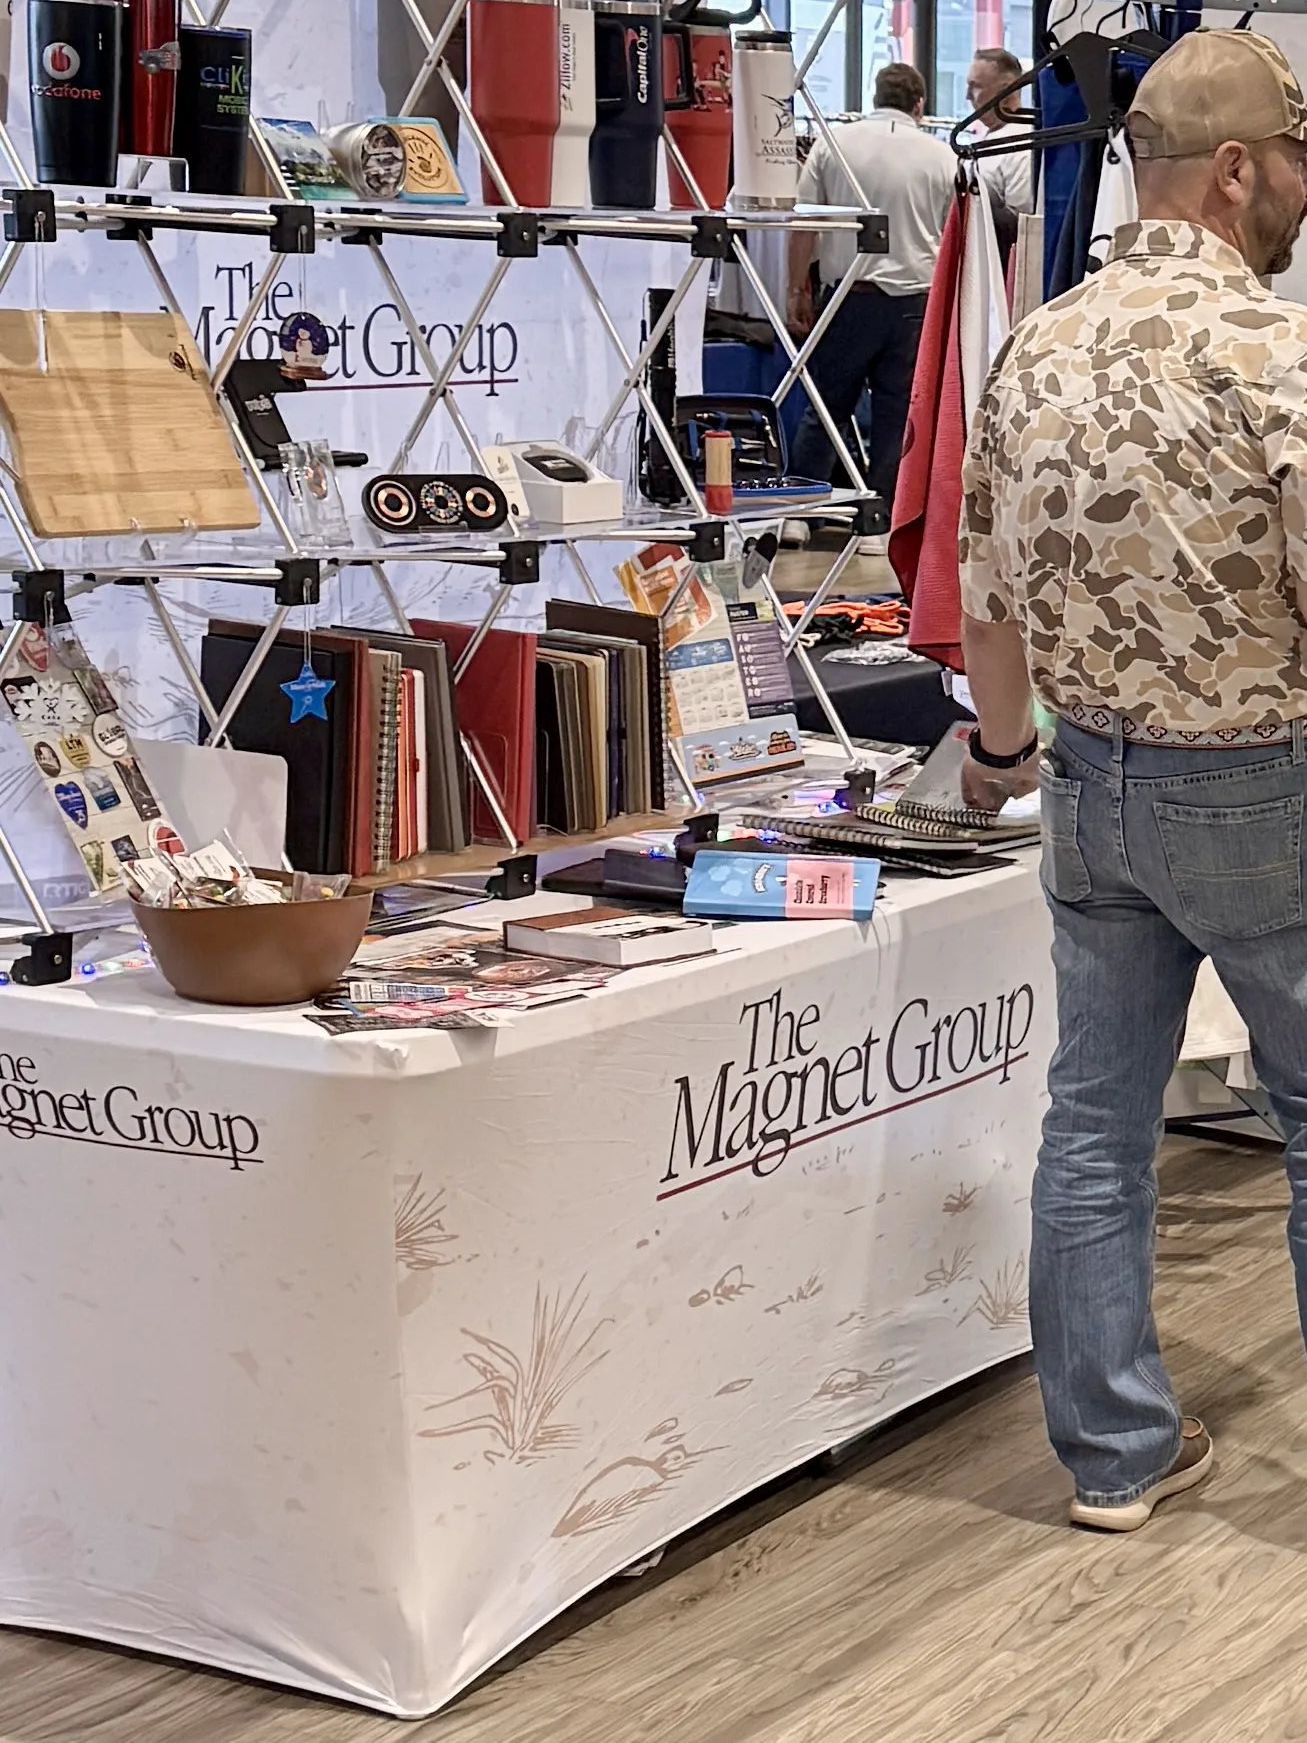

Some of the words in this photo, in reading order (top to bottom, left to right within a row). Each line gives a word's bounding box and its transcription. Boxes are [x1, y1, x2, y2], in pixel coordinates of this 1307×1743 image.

[362, 304, 518, 396] Group
[739, 986, 820, 1076] The
[659, 1025, 881, 1178] Magnet
[886, 983, 1034, 1093] Group
[104, 1086, 260, 1171] Group
